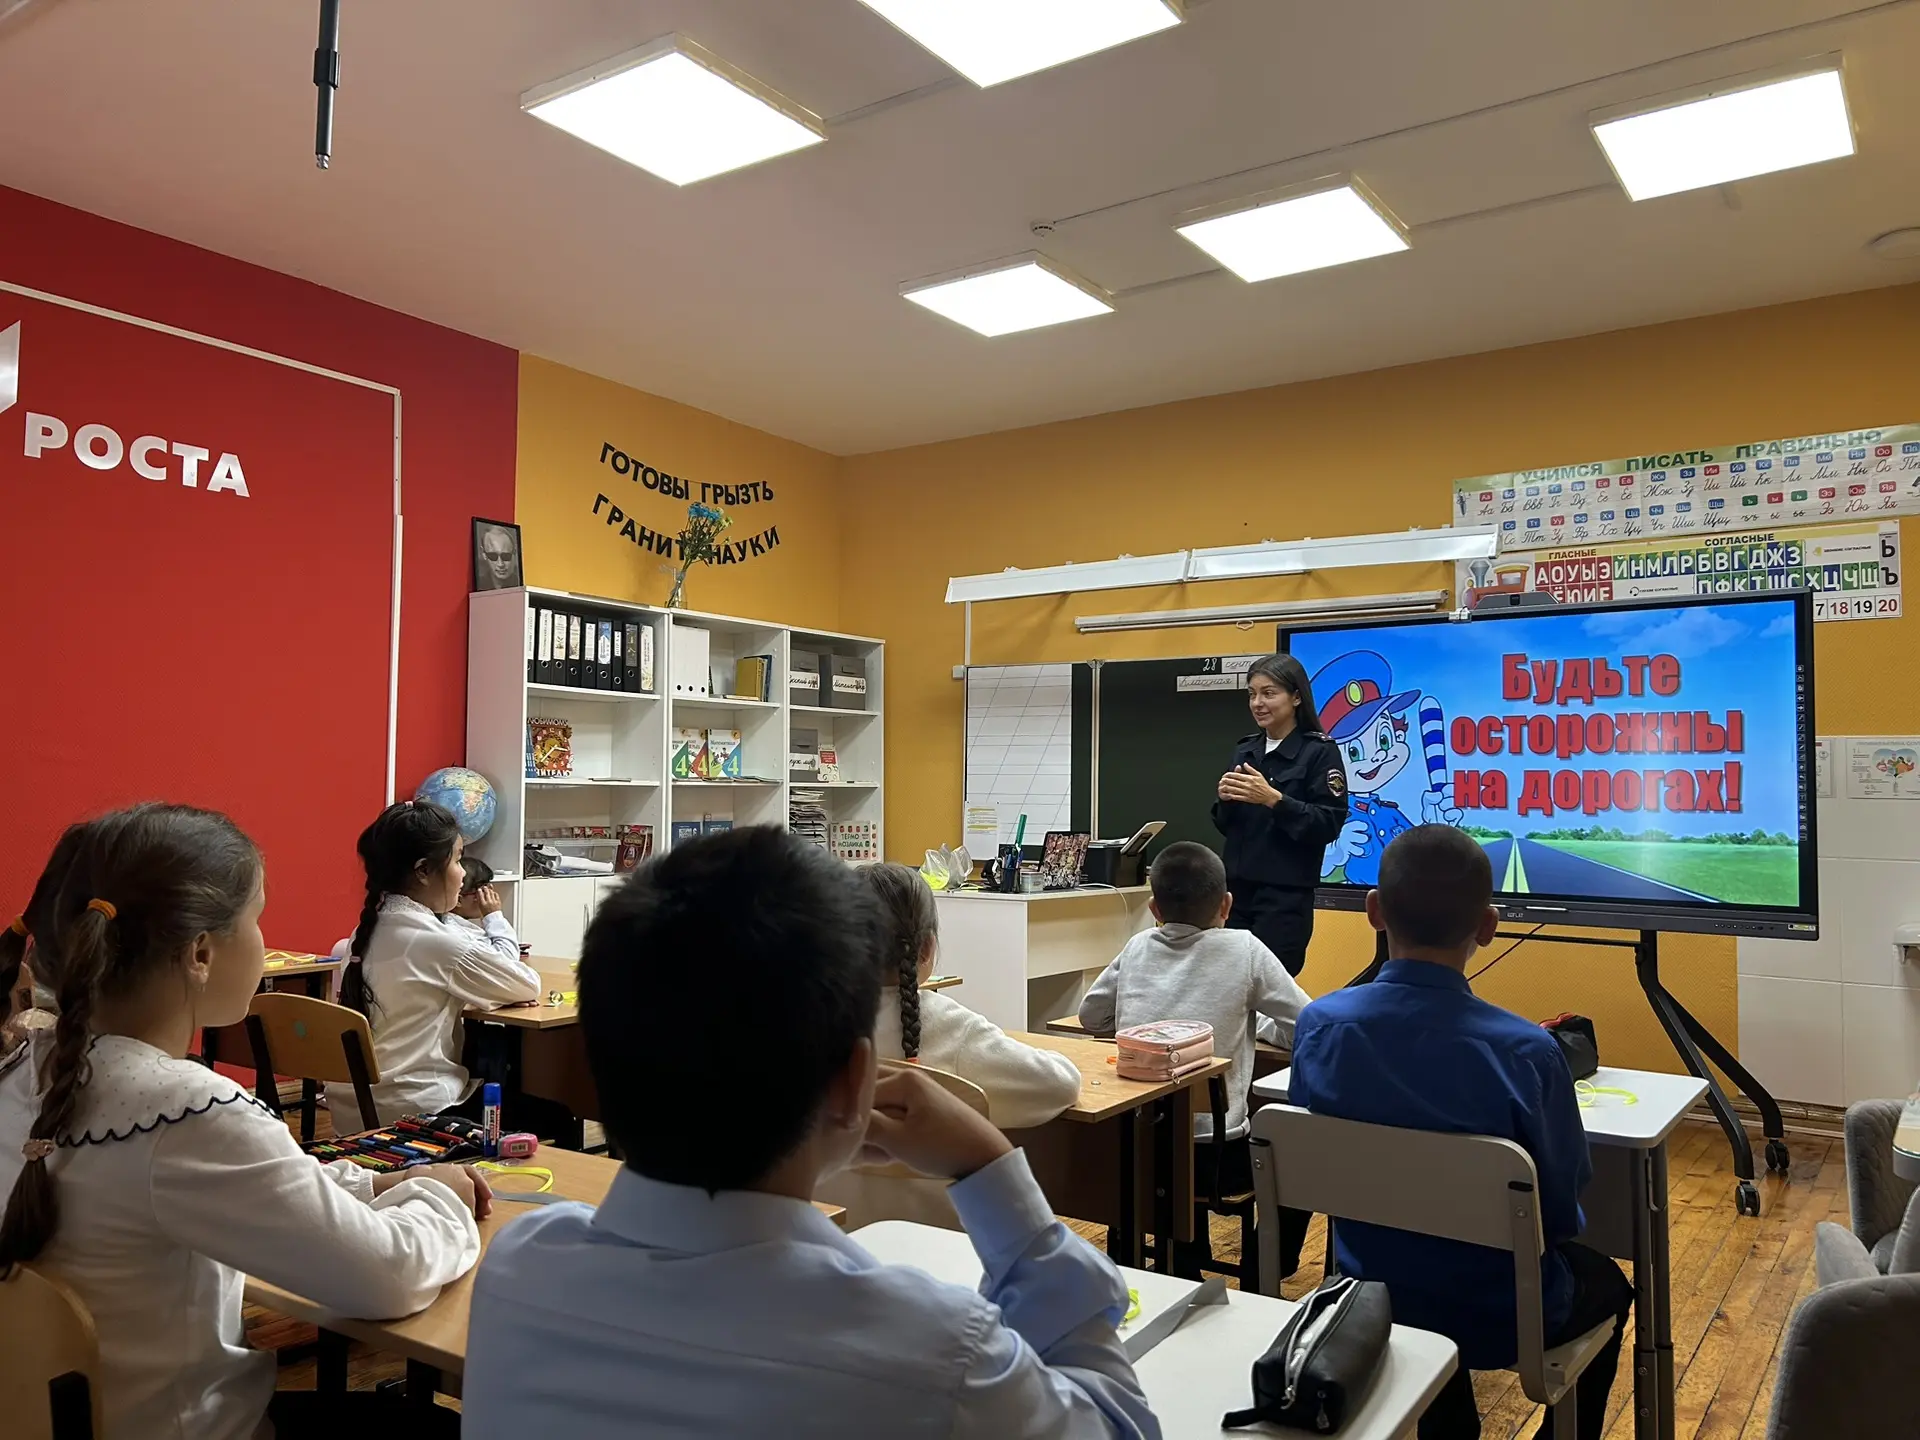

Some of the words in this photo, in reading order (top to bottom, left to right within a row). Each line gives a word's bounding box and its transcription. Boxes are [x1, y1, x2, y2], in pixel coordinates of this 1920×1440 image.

[23, 411, 250, 498] РОСТА
[1521, 463, 1603, 484] УЧИМСЯ
[1626, 450, 1714, 472] ПИСАТЬ
[1736, 430, 1882, 459] ПРАВИЛЬНО
[599, 441, 690, 500] ГОТОВЫ
[700, 480, 774, 506] ГРЫЗТЬ
[592, 492, 686, 561] ГРАНИТ
[708, 524, 781, 565] НАУКИ
[1704, 533, 1775, 547] СОГЛАСНЫЕ
[1881, 539, 1896, 558] Ь
[1548, 549, 1597, 560] ГЛАСНЫЕ
[1881, 566, 1899, 586] Ъ
[1815, 603, 1825, 616] 7
[1830, 601, 1849, 615] 18
[1854, 600, 1873, 614] 19
[1878, 598, 1898, 612] 20
[1202, 658, 1218, 672] 28
[1502, 653, 1681, 705] Будьте
[1450, 710, 1744, 759] осторожны
[675, 754, 688, 776] 4
[697, 754, 708, 776] 4
[727, 755, 739, 776] 4
[1453, 769, 1509, 809] на
[1517, 761, 1742, 816] дорогах!
